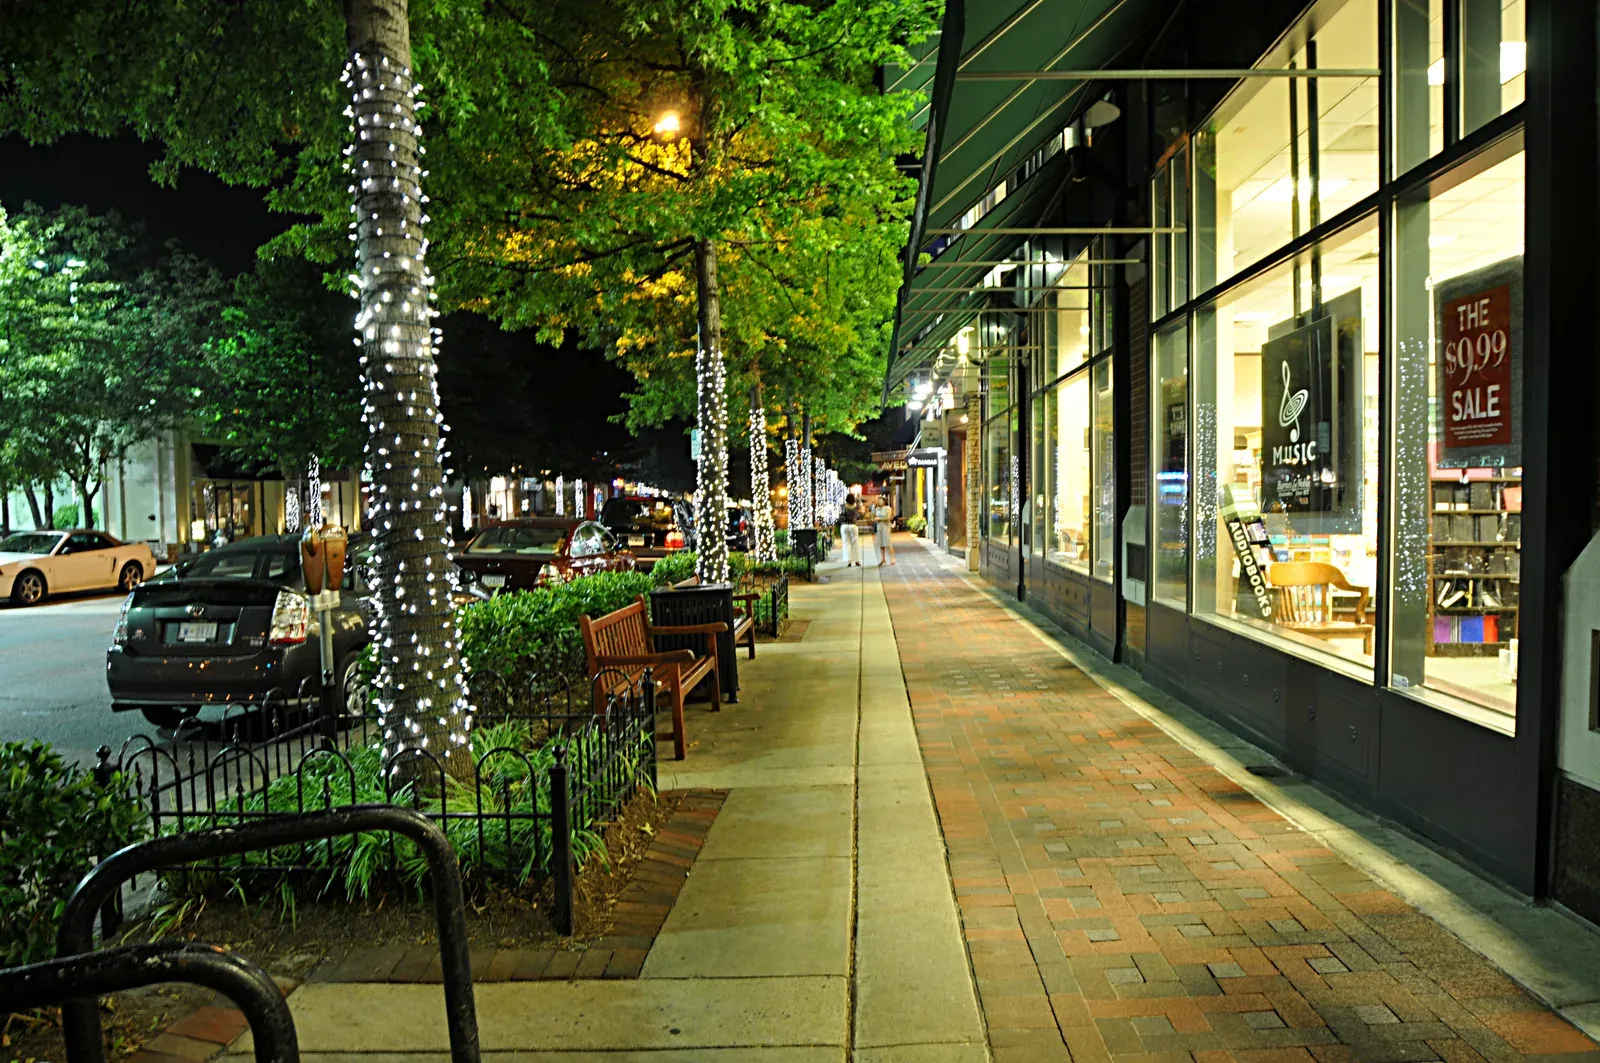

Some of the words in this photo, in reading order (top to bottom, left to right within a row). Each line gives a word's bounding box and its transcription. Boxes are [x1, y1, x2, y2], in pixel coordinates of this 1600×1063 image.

[1457, 298, 1490, 332] THE
[1445, 329, 1507, 386] $9.99
[1452, 384, 1500, 422] SALE
[1272, 440, 1316, 466] MUSIC
[1229, 521, 1272, 617] AUDIOBOOKS
